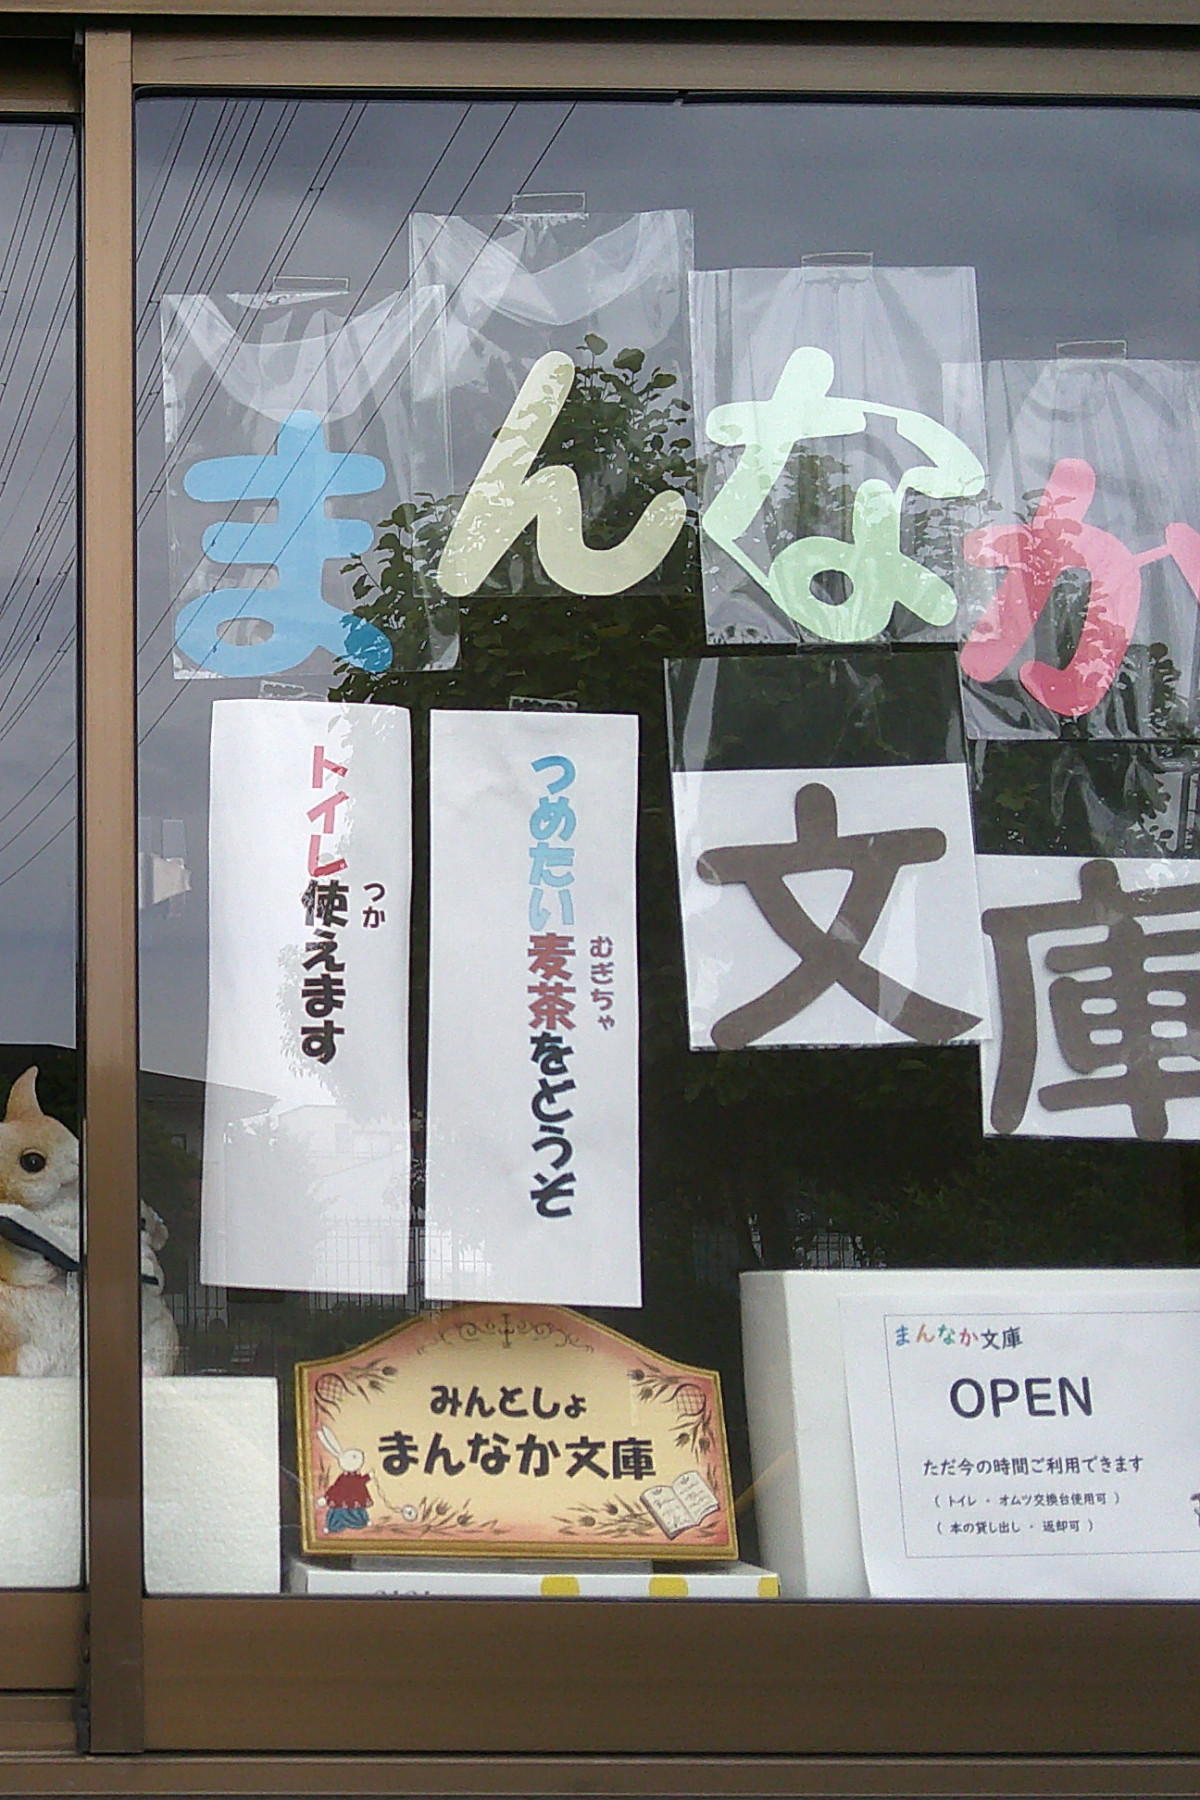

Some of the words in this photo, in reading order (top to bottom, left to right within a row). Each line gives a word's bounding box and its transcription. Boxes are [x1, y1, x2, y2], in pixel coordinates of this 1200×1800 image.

[300, 745, 349, 1065] トイレ使えます
[362, 882, 386, 928] つか
[590, 935, 615, 1031] むぎちゃ
[696, 782, 1200, 1141] 文庫
[895, 1324, 1023, 1350] まんなか文庫
[430, 1385, 588, 1420] みんとしょ
[949, 1376, 1093, 1419] OPEN
[377, 1431, 657, 1482] まんなか文庫
[923, 1455, 1144, 1477] ただ今の時間ご利用できます
